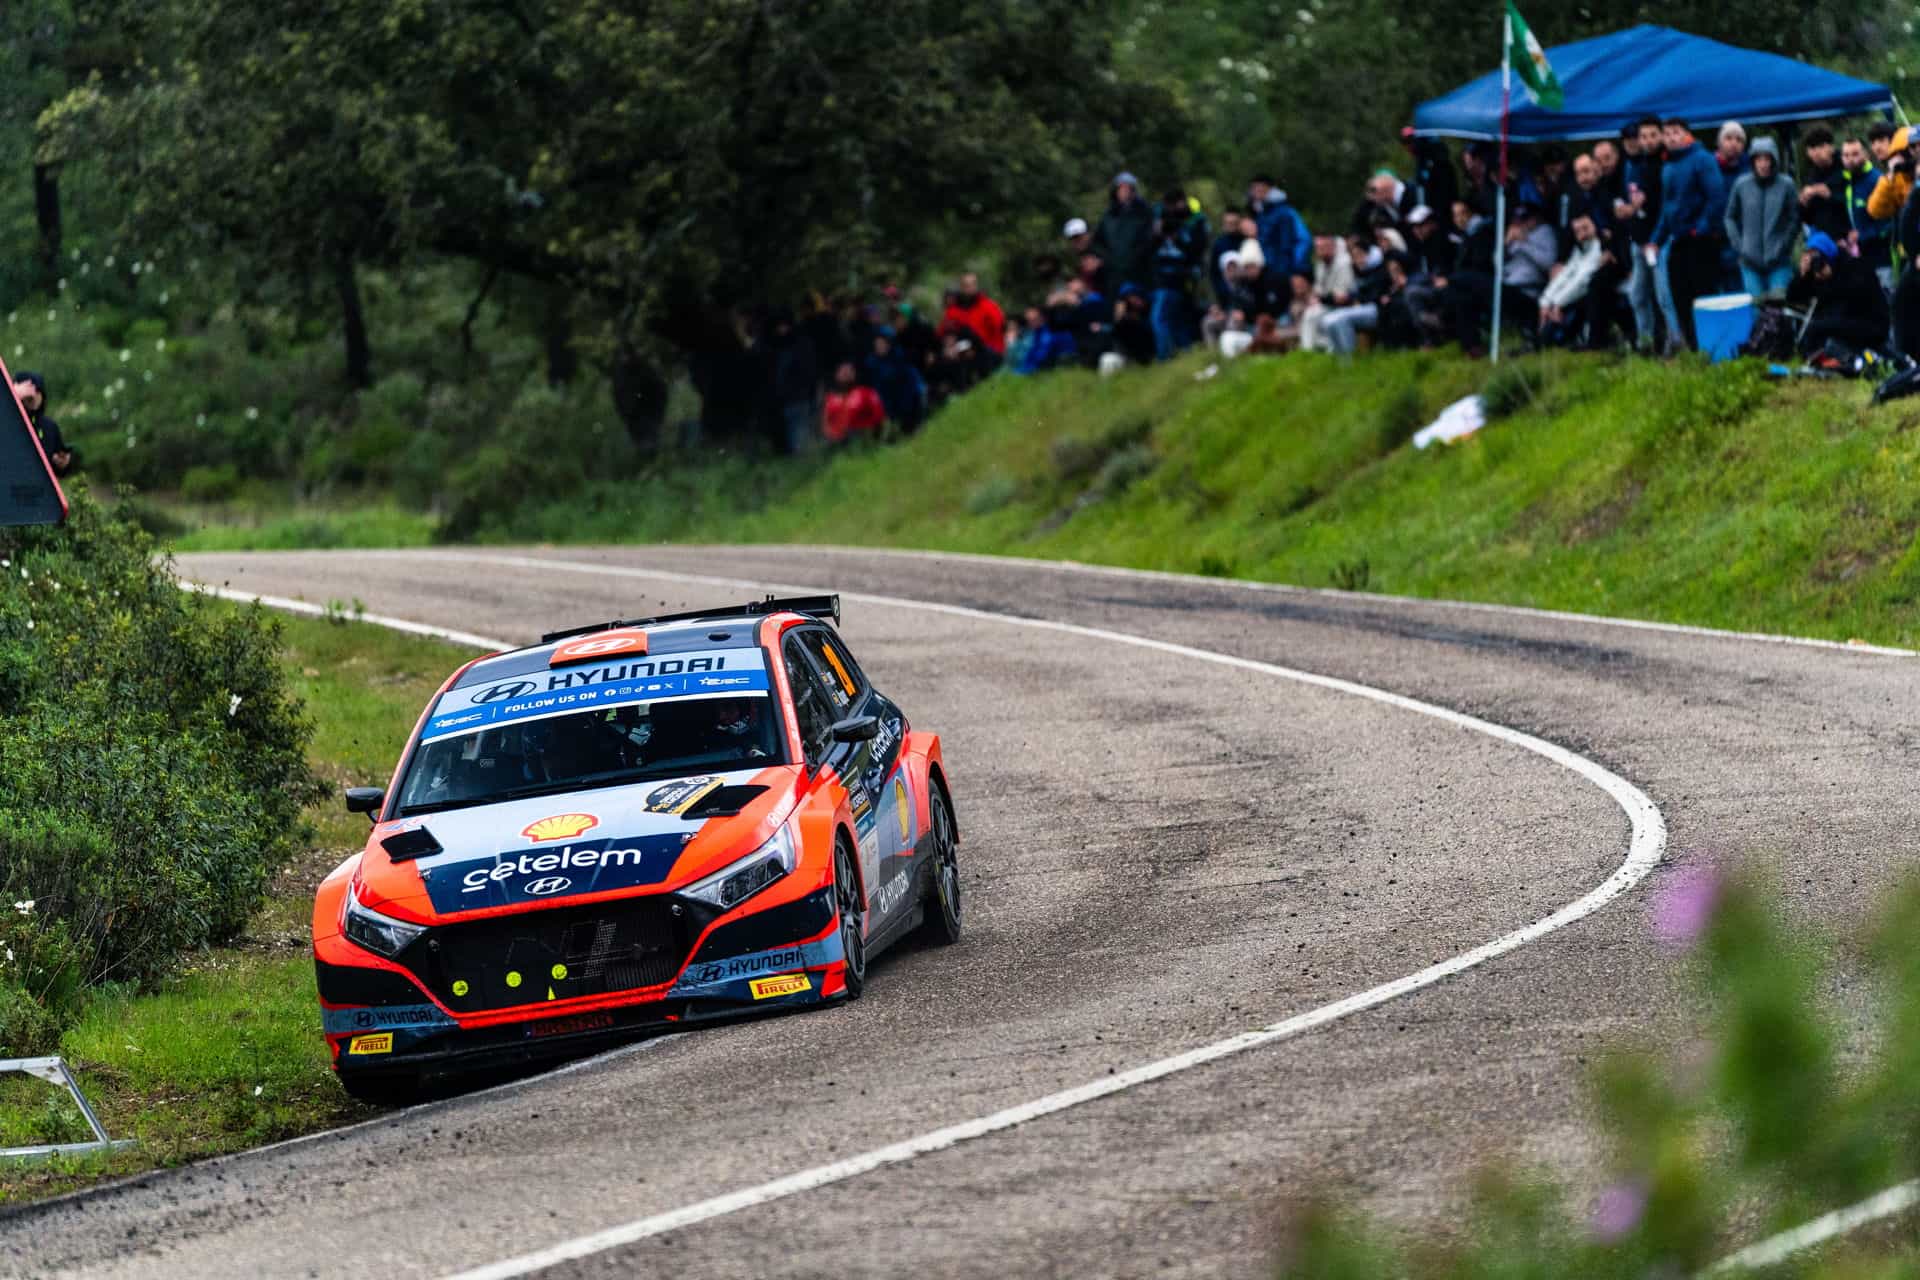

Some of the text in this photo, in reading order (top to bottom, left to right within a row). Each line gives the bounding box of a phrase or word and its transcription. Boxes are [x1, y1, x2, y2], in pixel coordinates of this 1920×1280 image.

[548, 656, 725, 690] HYUNDAI
[504, 691, 597, 713] FOLLOW US ON
[461, 846, 642, 893] cetelem
[729, 950, 803, 976] HYUNDAI
[756, 975, 806, 995] PIRELLI
[354, 1037, 389, 1052] PIRELLI
